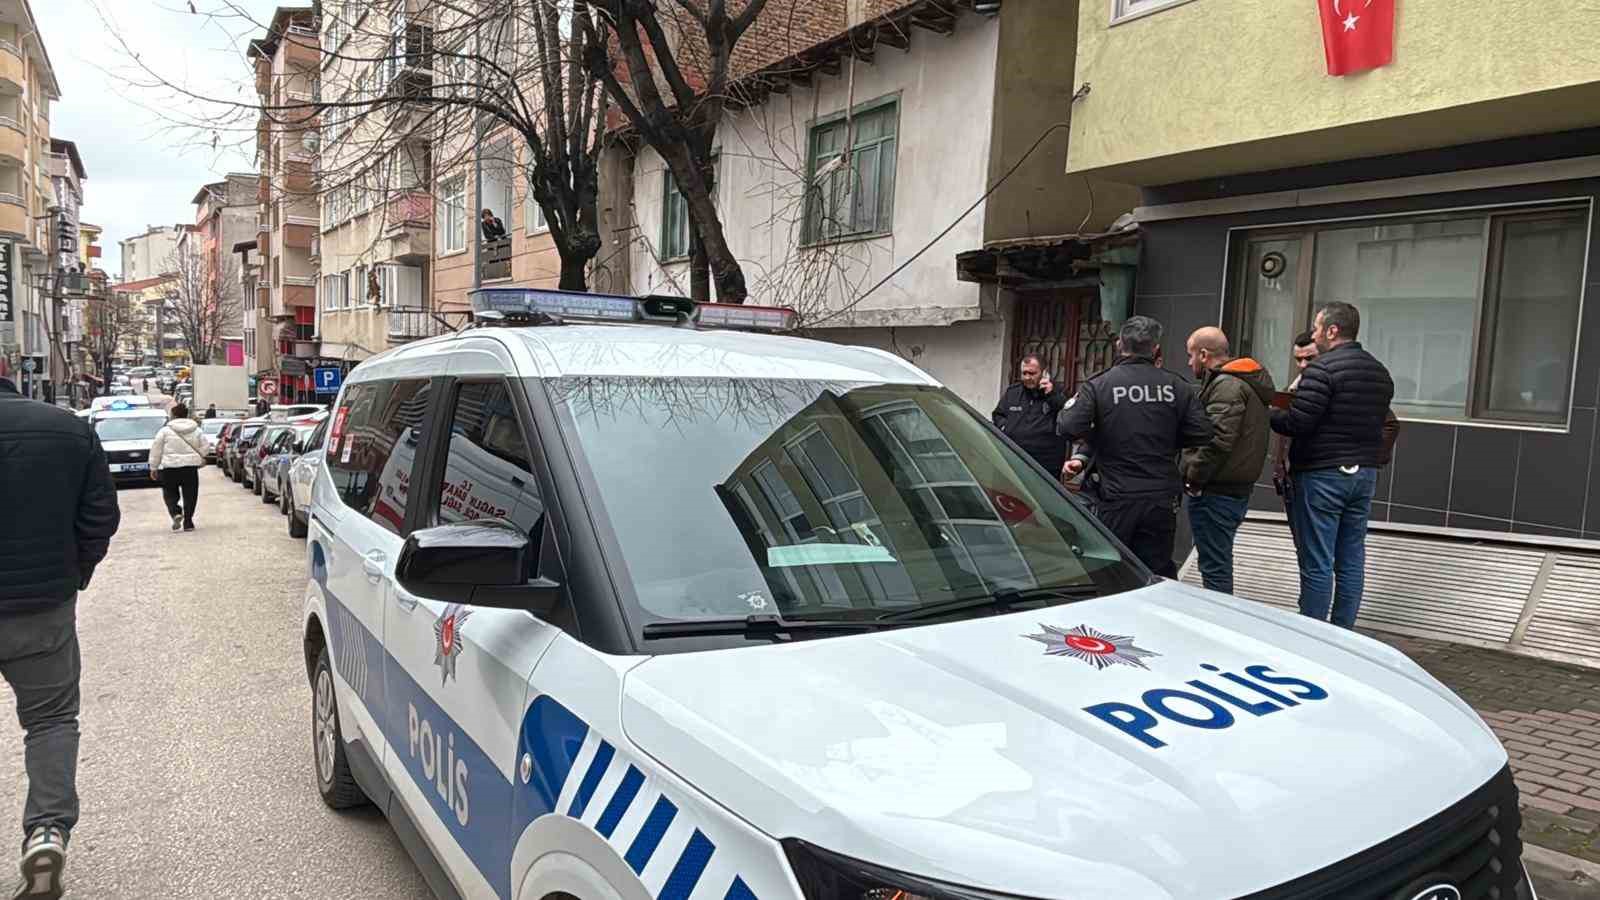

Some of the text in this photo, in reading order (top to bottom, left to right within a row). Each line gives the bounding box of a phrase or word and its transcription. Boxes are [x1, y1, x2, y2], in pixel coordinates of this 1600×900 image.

[323, 371, 335, 386] P
[1112, 384, 1176, 405] POLİS
[1082, 663, 1328, 749] POLİS
[408, 703, 469, 827] POLİS
